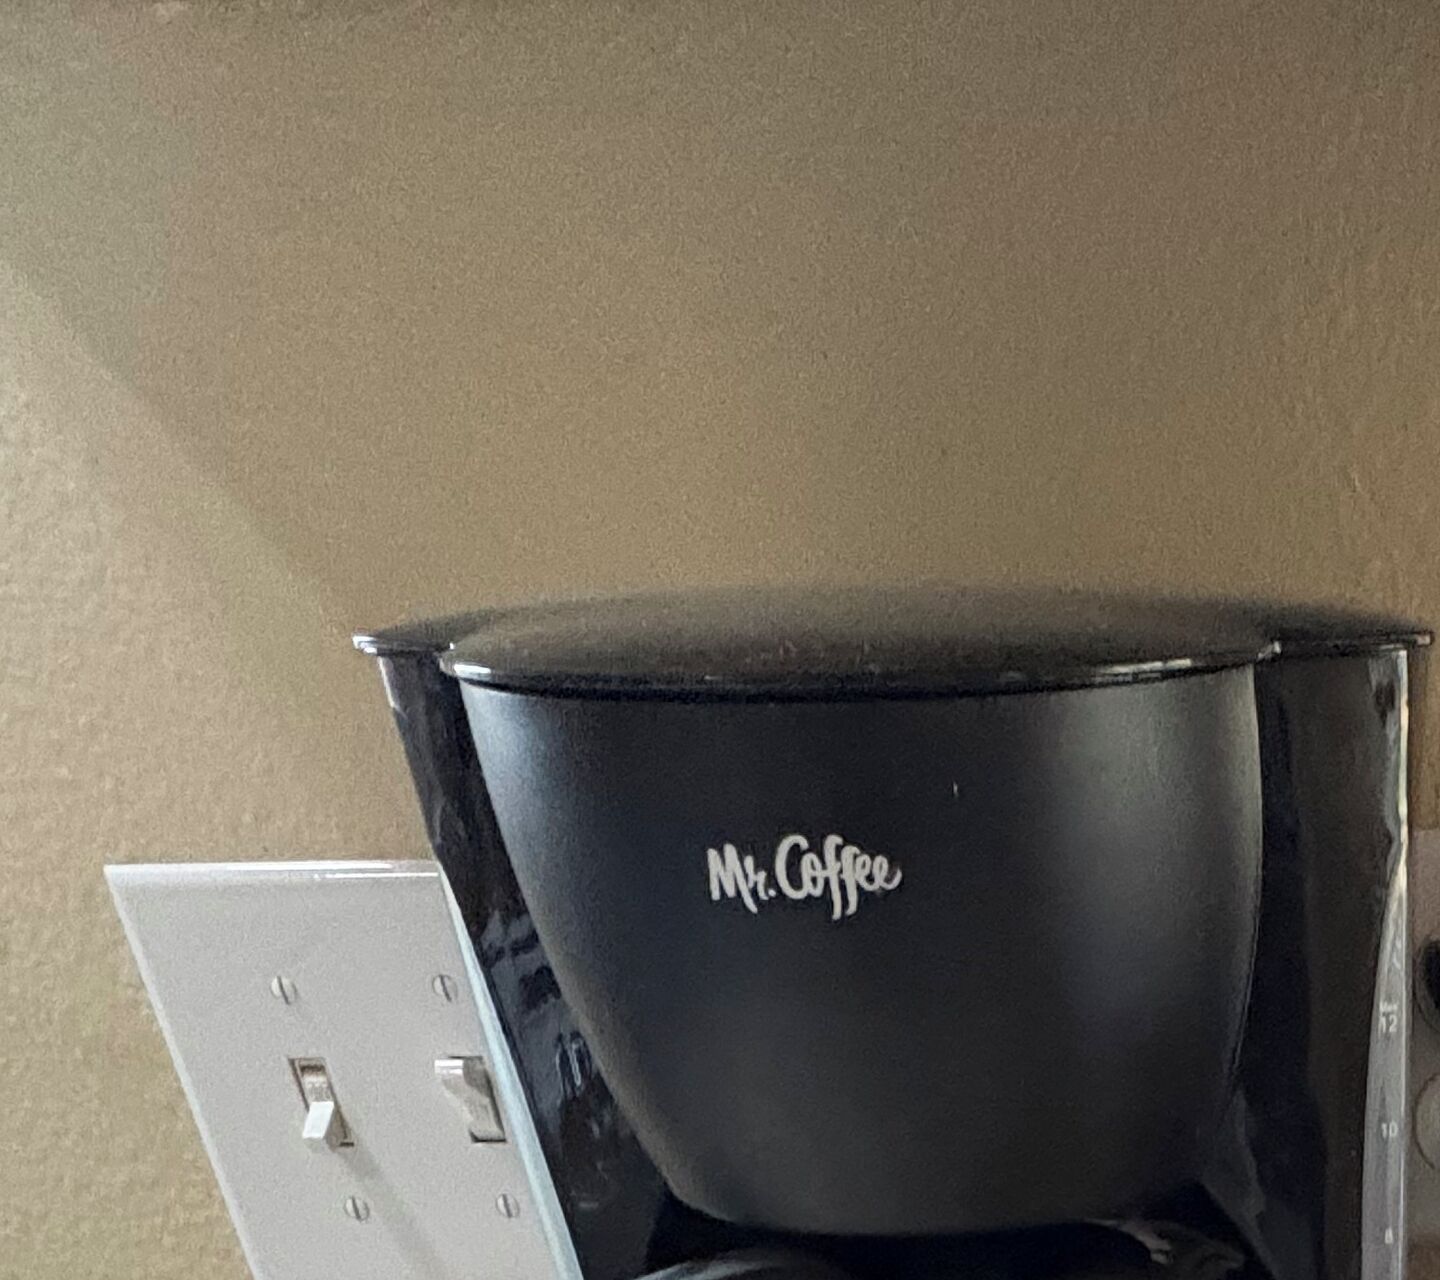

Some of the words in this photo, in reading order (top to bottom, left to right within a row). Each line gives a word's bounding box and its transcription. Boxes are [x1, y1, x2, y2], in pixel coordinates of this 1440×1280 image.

[707, 843, 776, 914] Mr.
[774, 834, 902, 920] Coffee
[1378, 1014, 1398, 1034] 12
